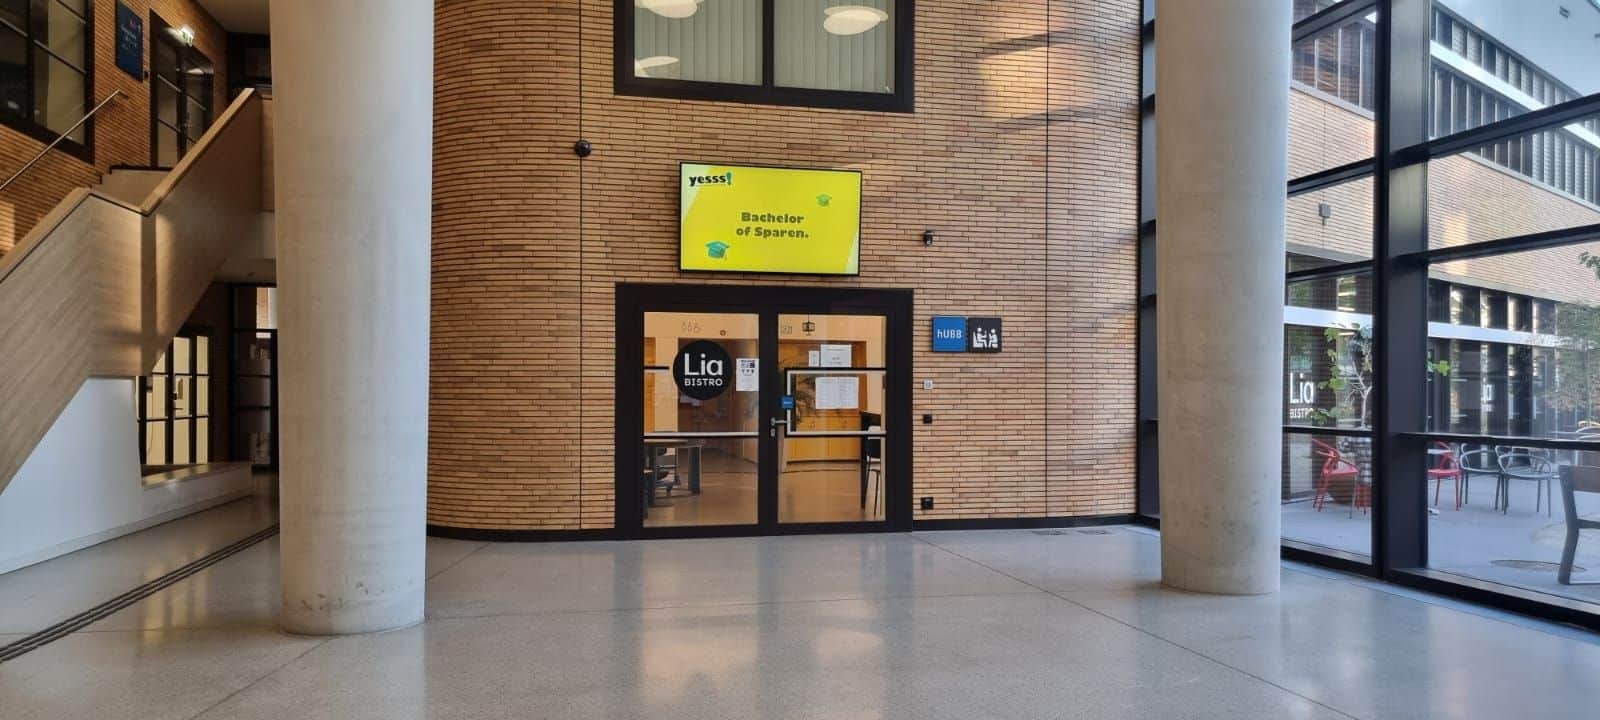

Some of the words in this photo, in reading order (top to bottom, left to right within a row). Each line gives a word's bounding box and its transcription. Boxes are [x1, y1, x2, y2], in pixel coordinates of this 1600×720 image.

[689, 172, 732, 187] yesss!
[741, 211, 805, 224] Bachelor
[736, 226, 751, 237] of
[754, 227, 809, 239] Sparen.
[937, 328, 962, 339] hUBB
[684, 353, 723, 376] Lia
[684, 378, 723, 387] BISTRO
[1289, 372, 1314, 404] Lia
